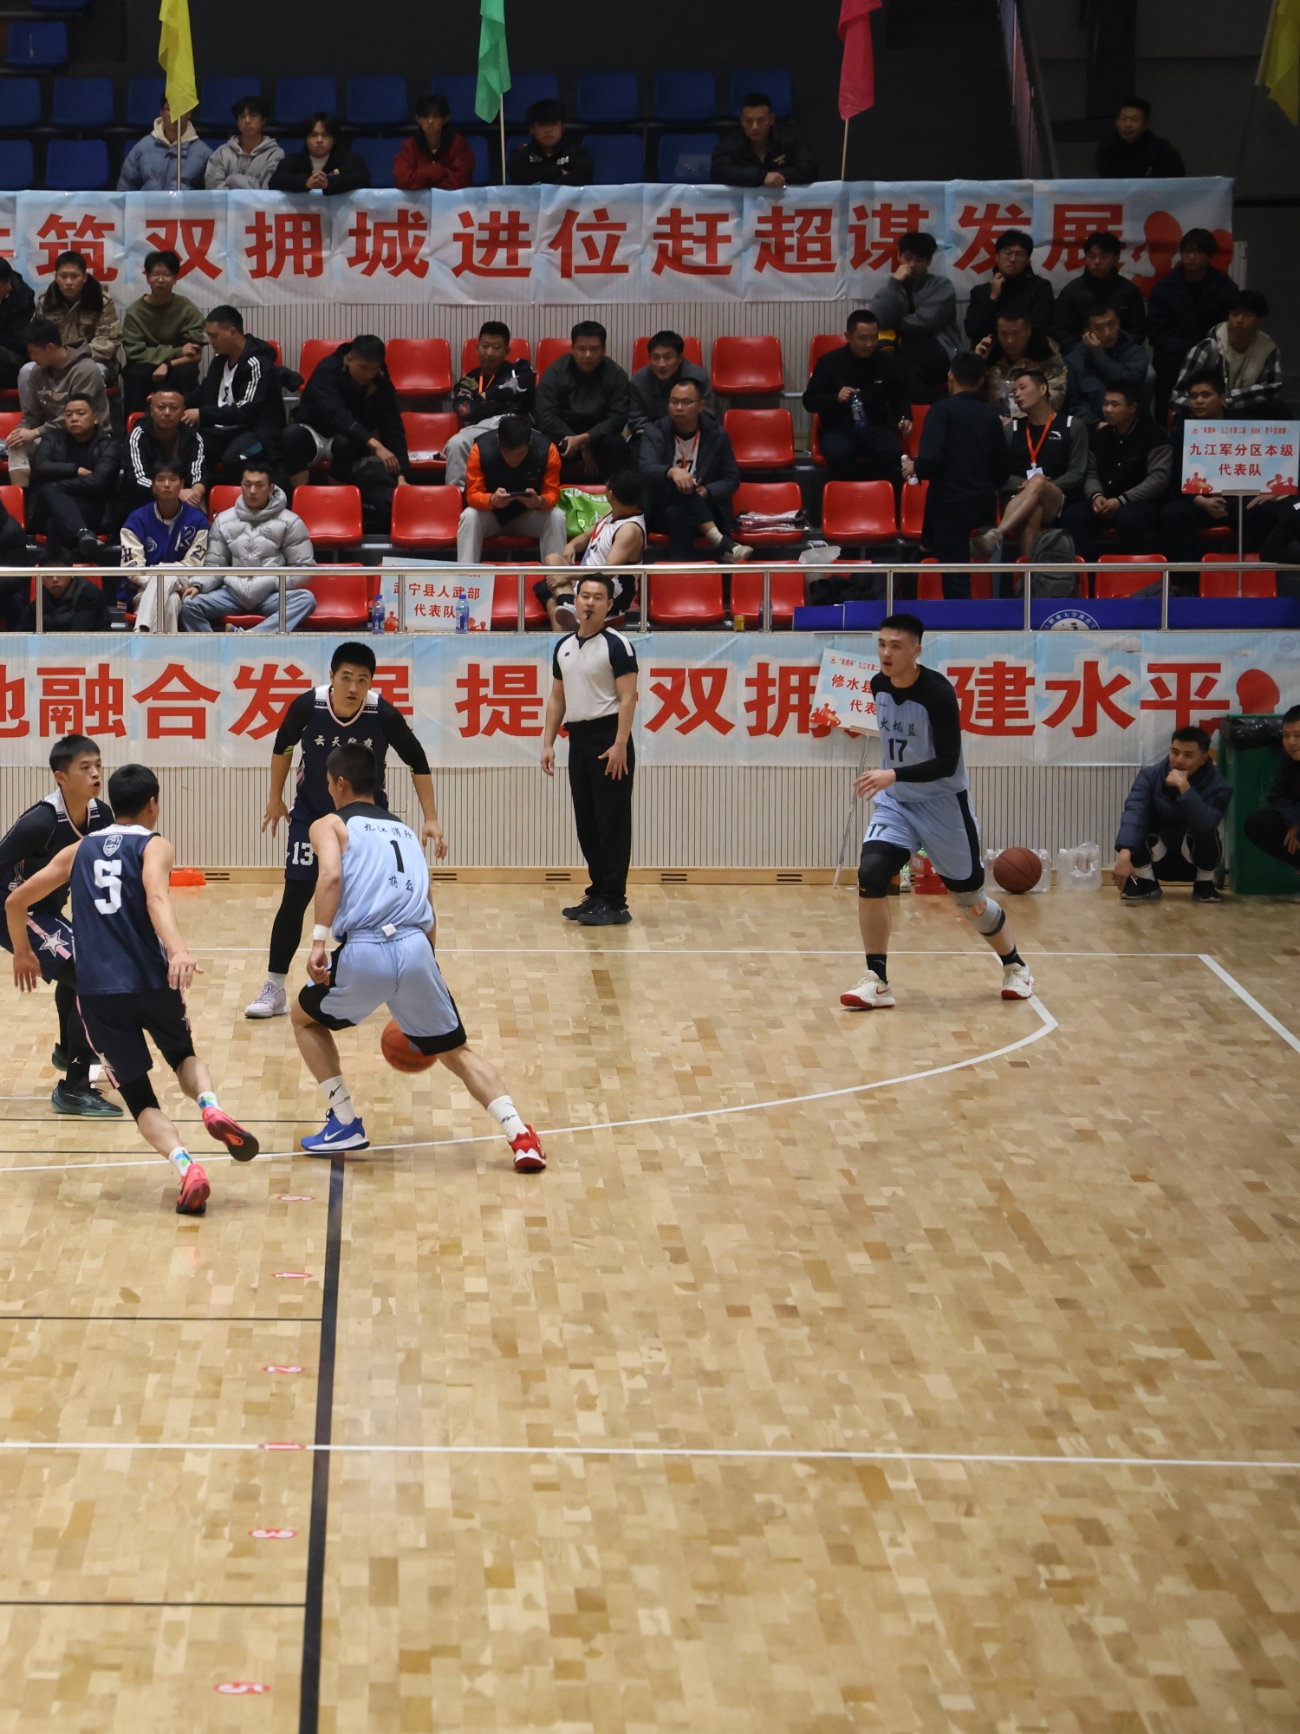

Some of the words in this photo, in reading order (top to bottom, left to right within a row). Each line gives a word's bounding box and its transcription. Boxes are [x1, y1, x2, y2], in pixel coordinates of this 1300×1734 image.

[1189, 443, 1294, 456] 九江军分区本级
[1218, 463, 1262, 476] 代表队
[413, 603, 456, 618] 代表队
[455, 660, 1230, 738] 提双拥建水平
[880, 717, 917, 737] 火焰蓝
[888, 738, 908, 762] 17
[868, 823, 889, 838] 17
[291, 841, 314, 866] 13
[390, 839, 405, 873] 1
[93, 859, 123, 915] 5
